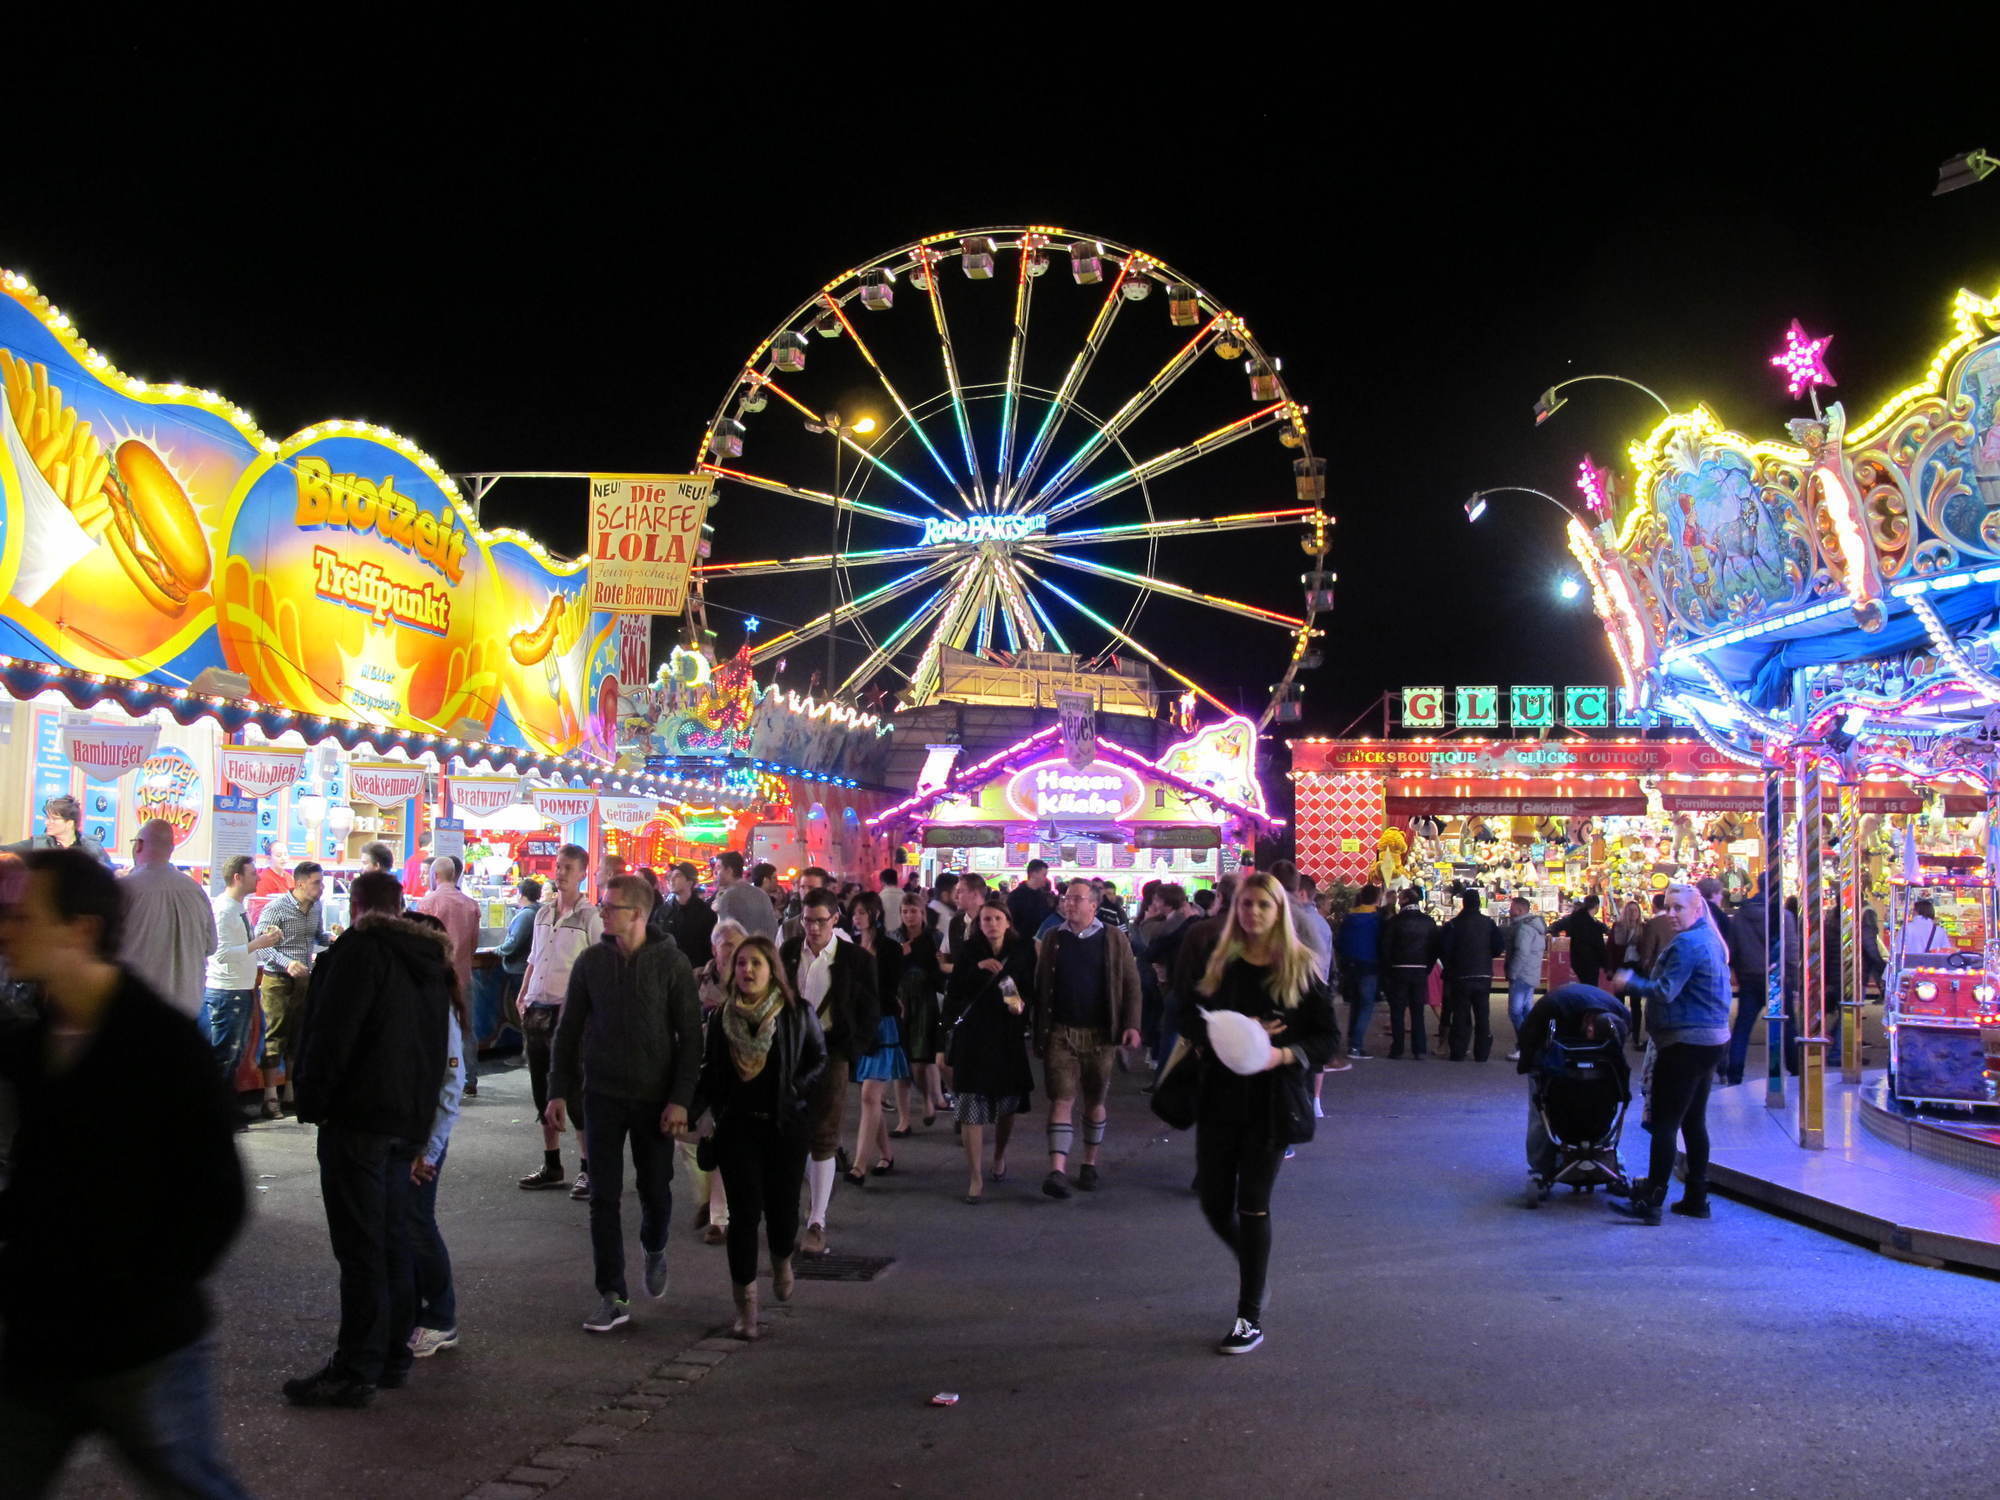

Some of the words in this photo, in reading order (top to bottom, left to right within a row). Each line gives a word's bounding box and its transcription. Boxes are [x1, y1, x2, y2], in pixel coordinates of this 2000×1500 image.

[593, 482, 621, 498] NEU!
[630, 484, 666, 504] Die
[678, 483, 708, 500] NEU!
[294, 455, 468, 587] Brotzeit
[596, 503, 697, 532] SCHARFE
[595, 532, 687, 563] LOLA
[314, 545, 450, 637] Treffpunkt
[594, 582, 624, 605] Rote
[624, 583, 681, 607] Bratwurst
[73, 740, 144, 768] Hamburger
[1036, 769, 1122, 791] Hexen
[457, 788, 511, 808] Bratwurst
[540, 799, 589, 815] POMMES
[1037, 792, 1122, 815] Küche
